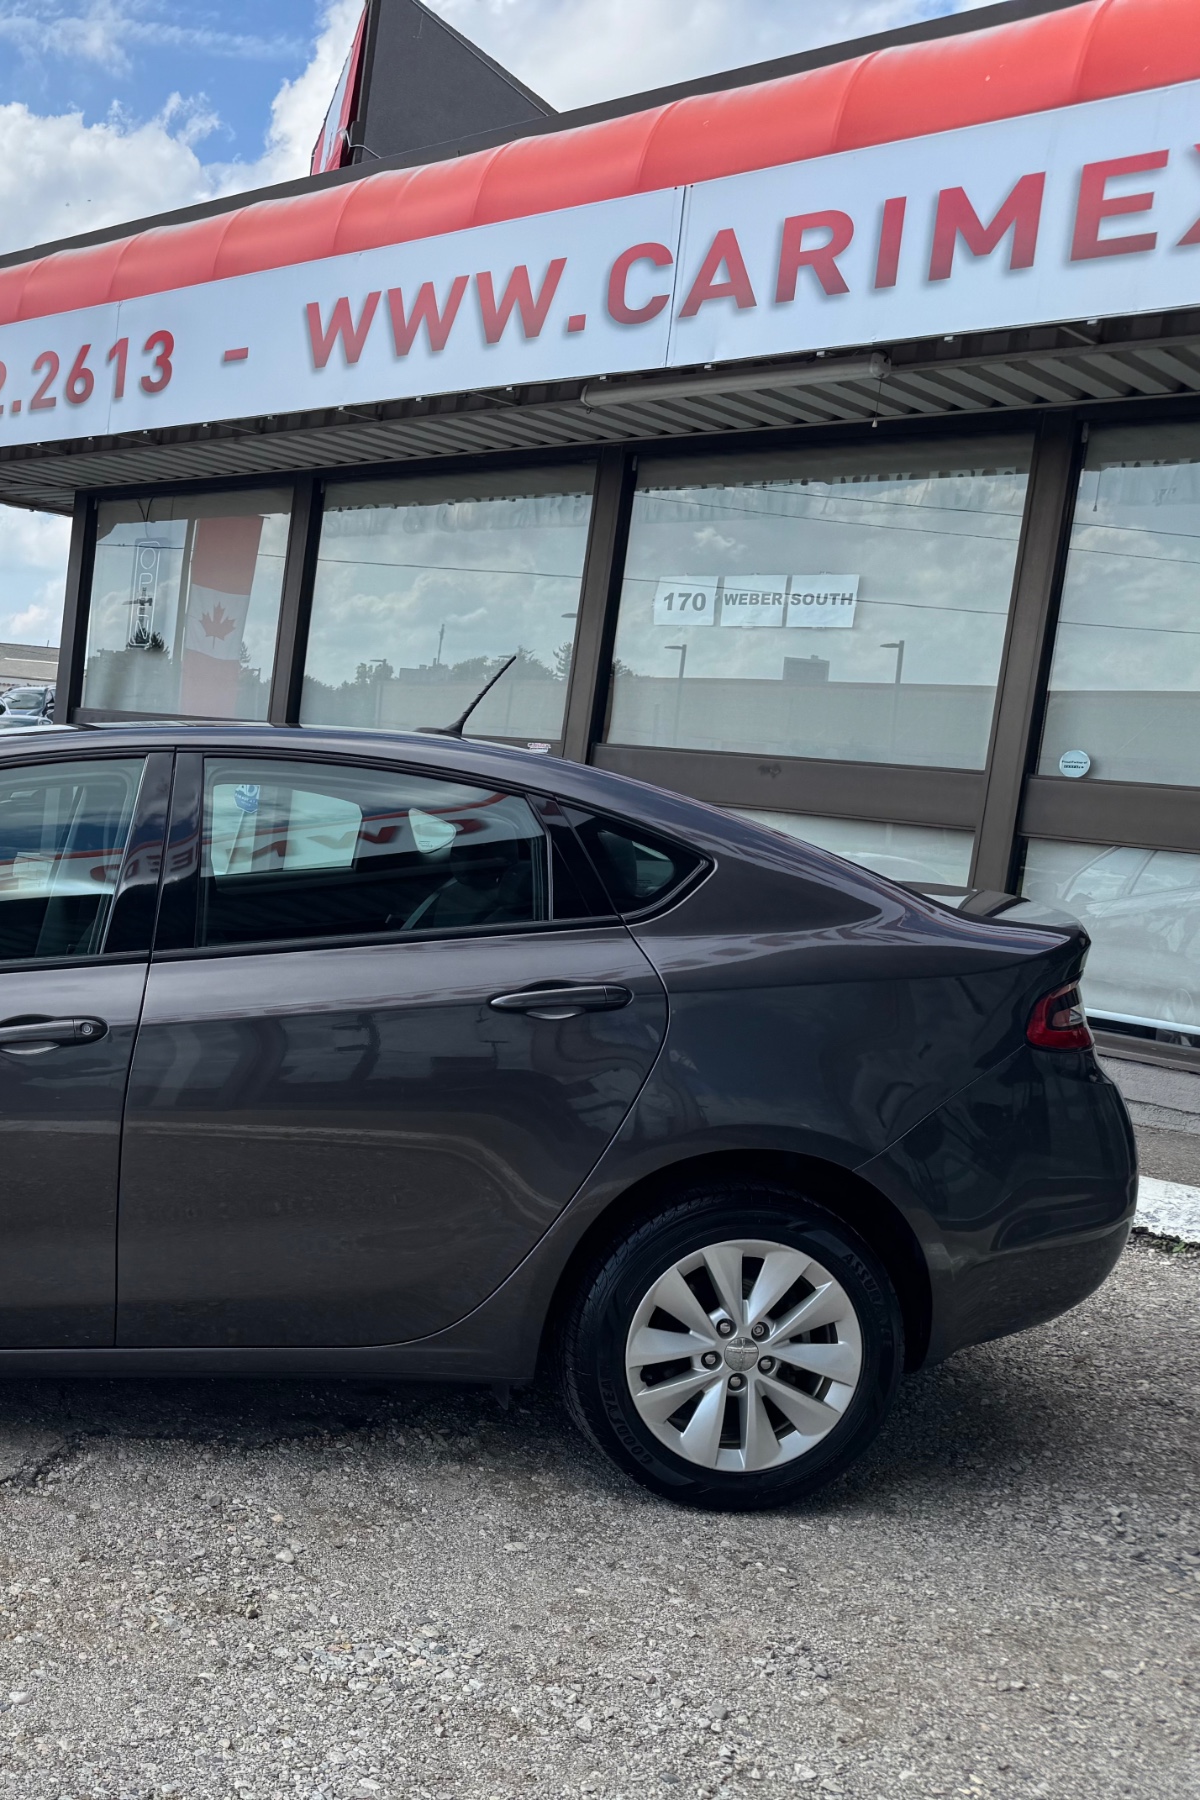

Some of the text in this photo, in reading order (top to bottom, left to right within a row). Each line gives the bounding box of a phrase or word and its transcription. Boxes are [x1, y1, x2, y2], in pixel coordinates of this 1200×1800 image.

[305, 141, 1200, 369] WWW.CARIME
[663, 592, 854, 612] 170 WEBER SOUTH
[599, 1373, 655, 1464] GOODYEA
